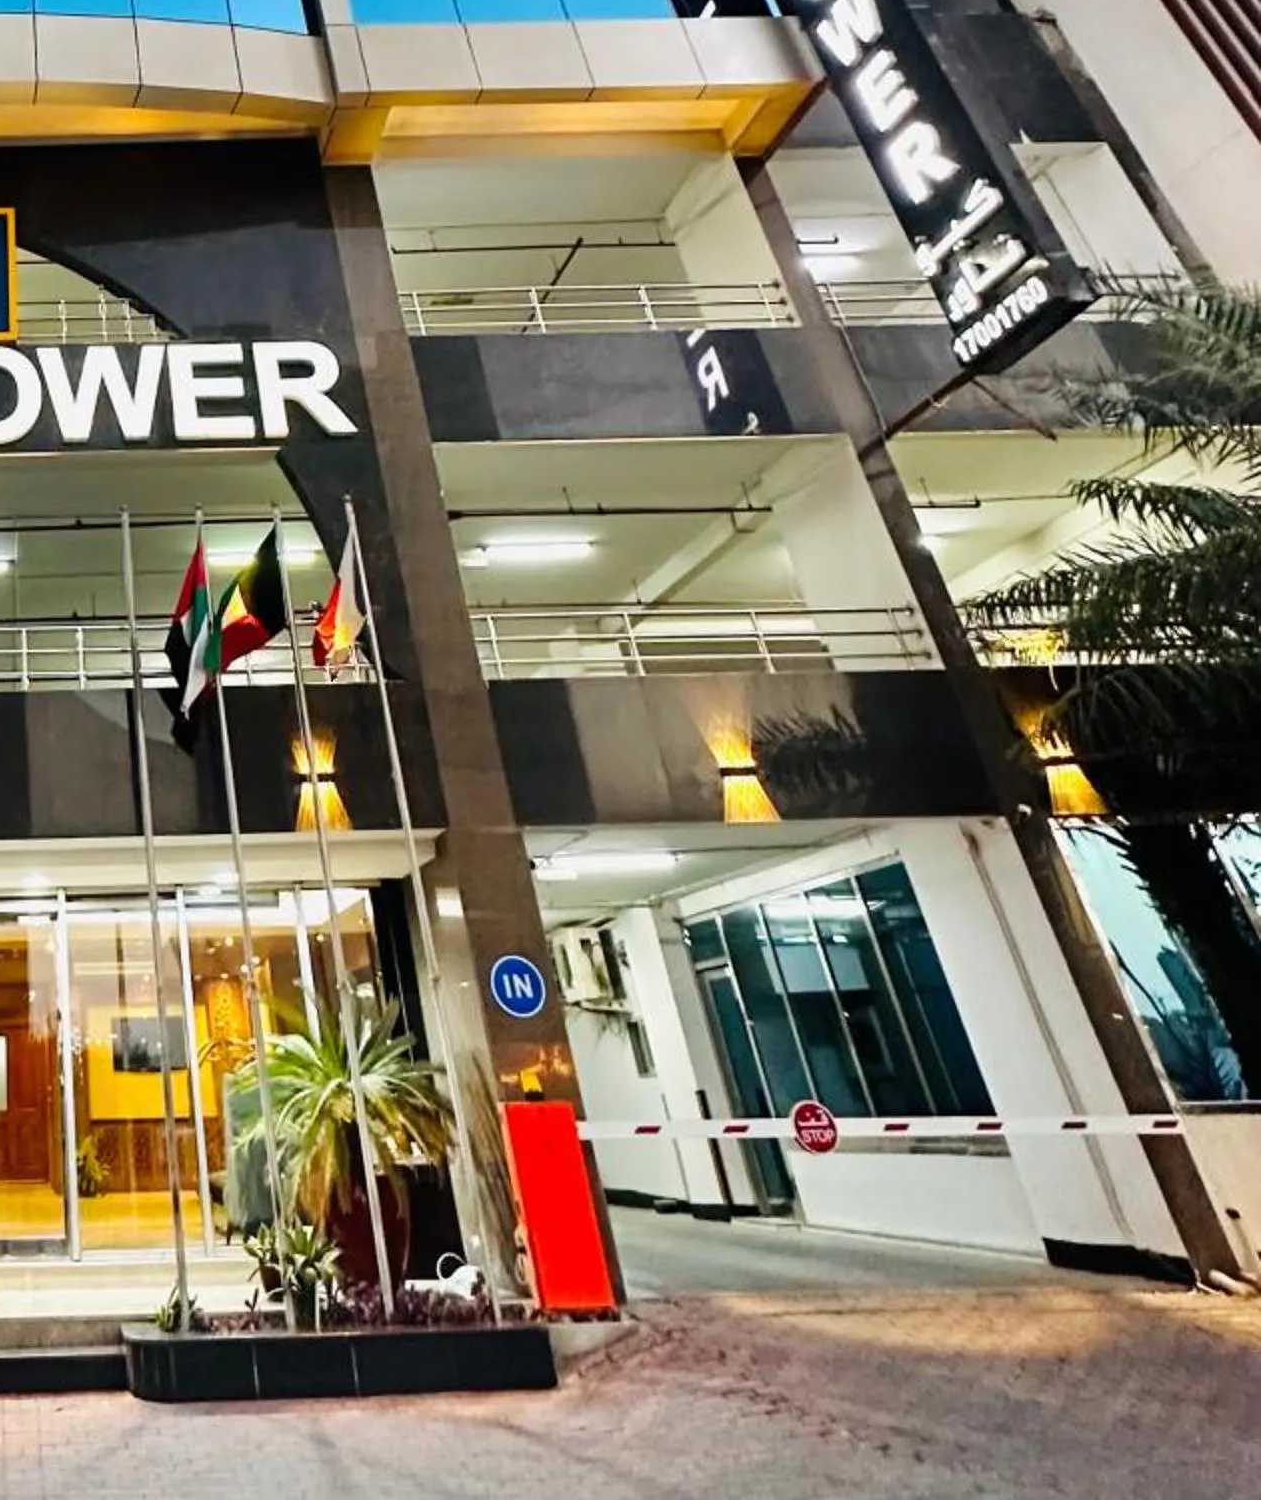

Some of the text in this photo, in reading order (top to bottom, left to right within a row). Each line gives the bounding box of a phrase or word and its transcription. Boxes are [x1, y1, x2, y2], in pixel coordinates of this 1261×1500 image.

[952, 275, 1048, 363] 17001760
[502, 973, 534, 999] IN
[798, 1109, 830, 1127] قف
[801, 1129, 835, 1143] STOP
